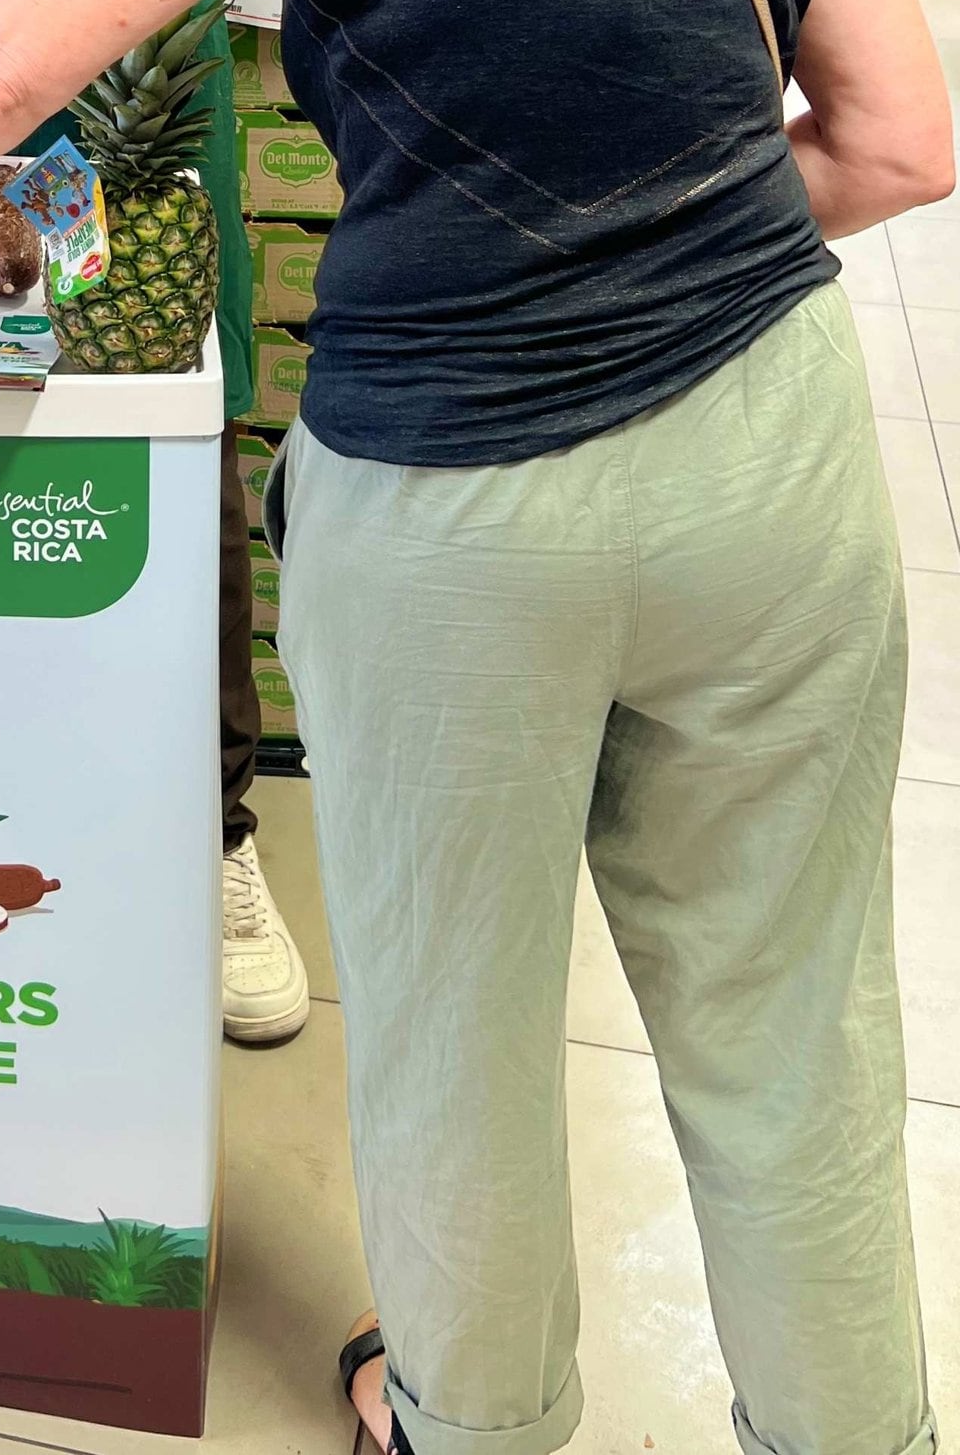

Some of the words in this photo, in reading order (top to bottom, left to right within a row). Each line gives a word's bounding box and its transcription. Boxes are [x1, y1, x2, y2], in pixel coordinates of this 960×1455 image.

[266, 151, 287, 165] Del
[288, 152, 328, 166] Monte
[283, 266, 303, 279] Del
[11, 518, 108, 541] COSTA
[13, 541, 83, 562] RICA
